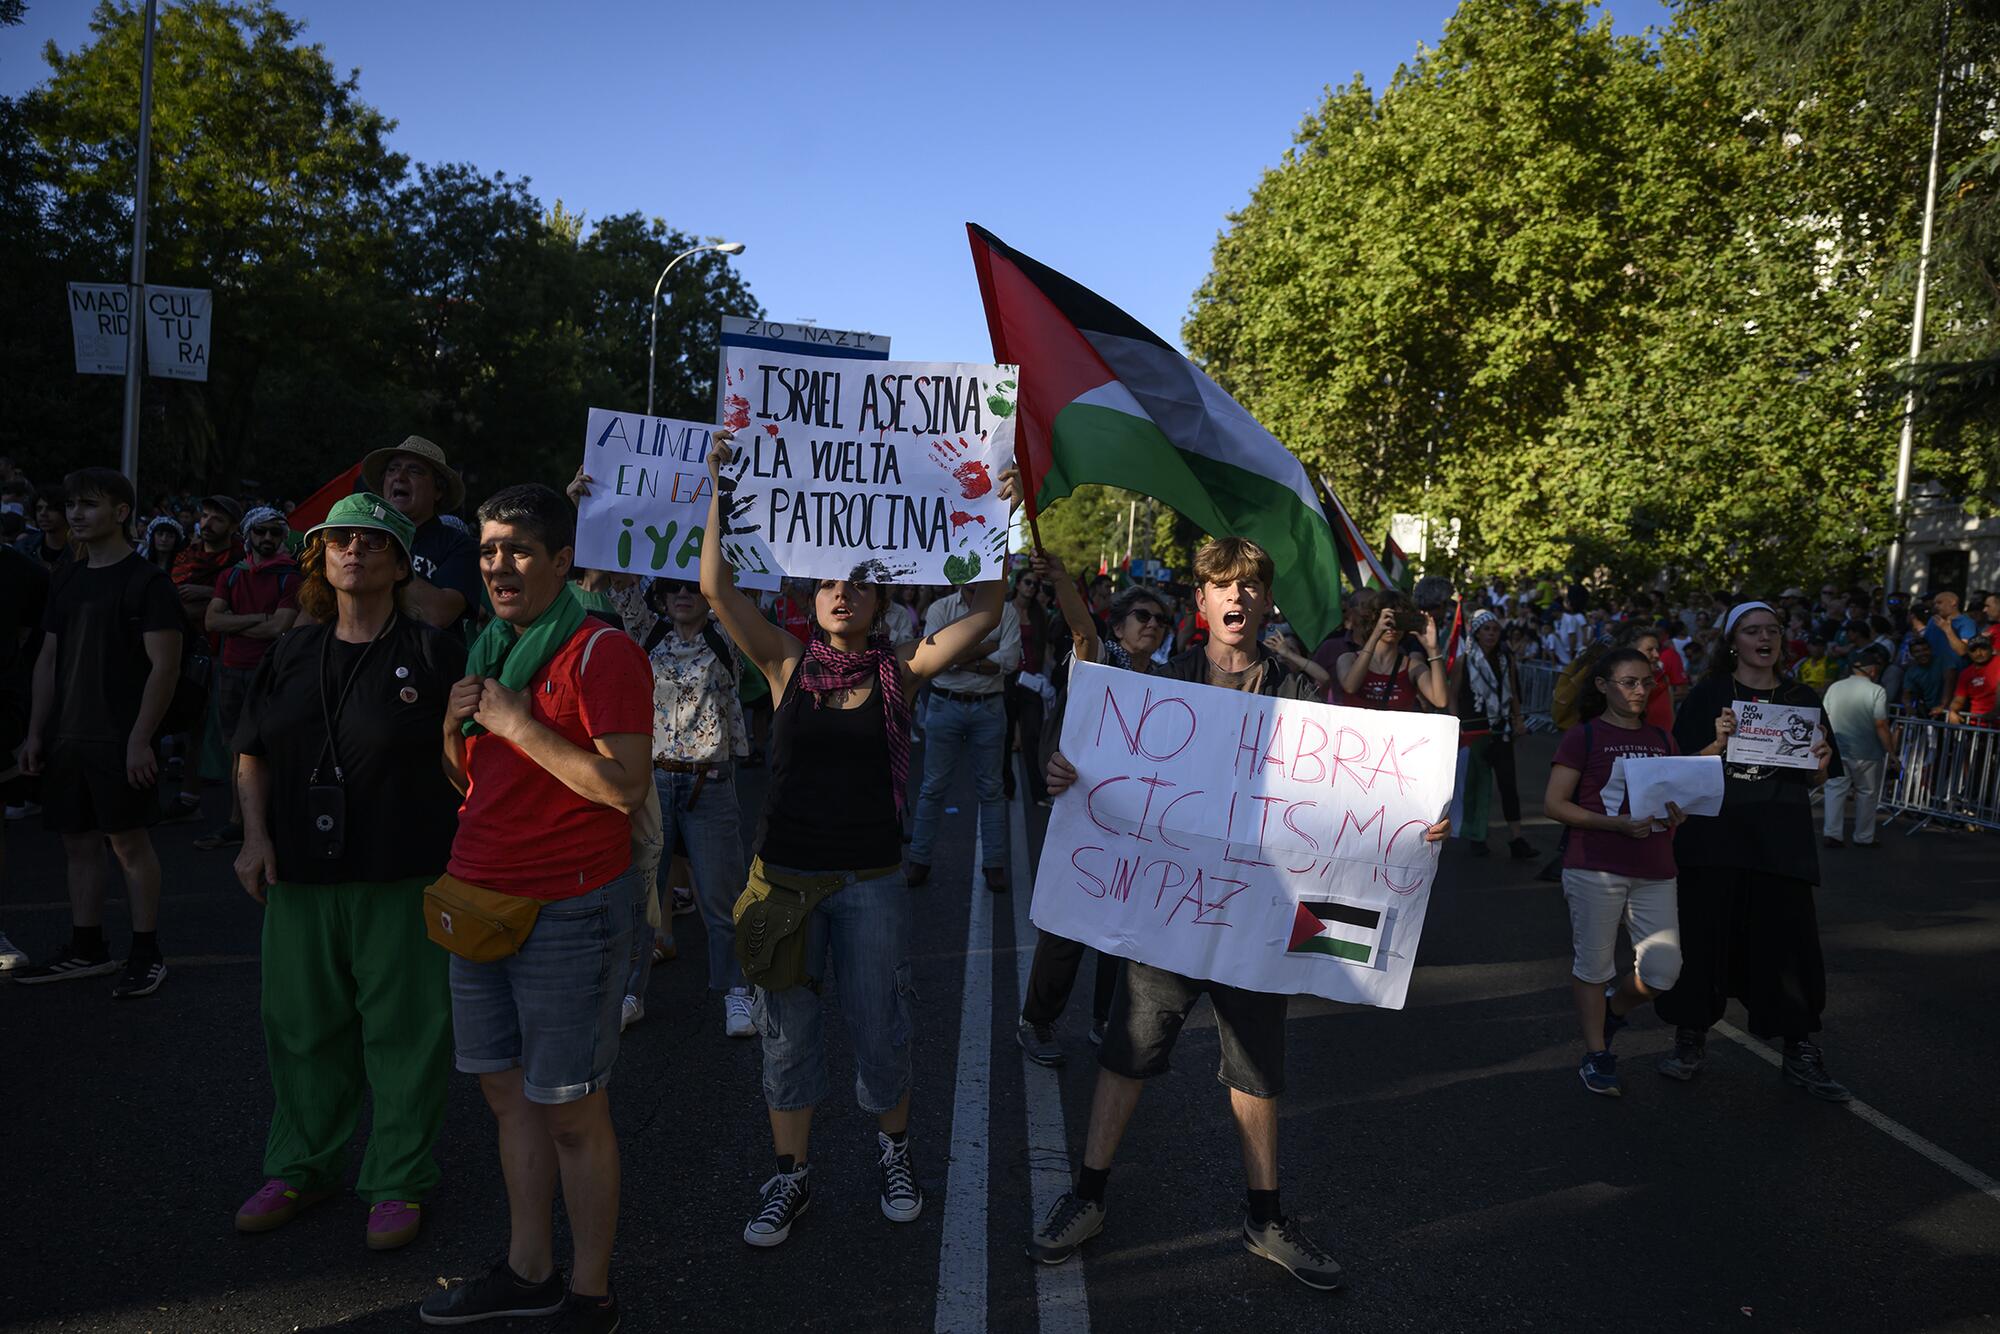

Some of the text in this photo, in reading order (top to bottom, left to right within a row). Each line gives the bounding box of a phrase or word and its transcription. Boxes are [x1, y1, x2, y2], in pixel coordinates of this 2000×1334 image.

[72, 290, 128, 313] MAD
[149, 294, 200, 319] CUL
[98, 314, 129, 335] RID
[159, 317, 192, 340] TU
[745, 320, 784, 340] ZIO
[179, 342, 205, 364] RA
[756, 364, 988, 441] ISRAEL ASESINA,
[754, 436, 902, 485] LA VUELTA
[616, 465, 713, 504] EN GA
[769, 488, 951, 553] PATROCINA
[617, 518, 739, 583] ¡YA
[1742, 712, 1763, 720] CON
[1743, 704, 1758, 712] NO
[1095, 685, 1430, 796] NO HABRÁ
[1739, 726, 1783, 737] SILENCIO
[1604, 744, 1648, 752] PALESTINA
[1071, 846, 1249, 928] SIN PAZ
